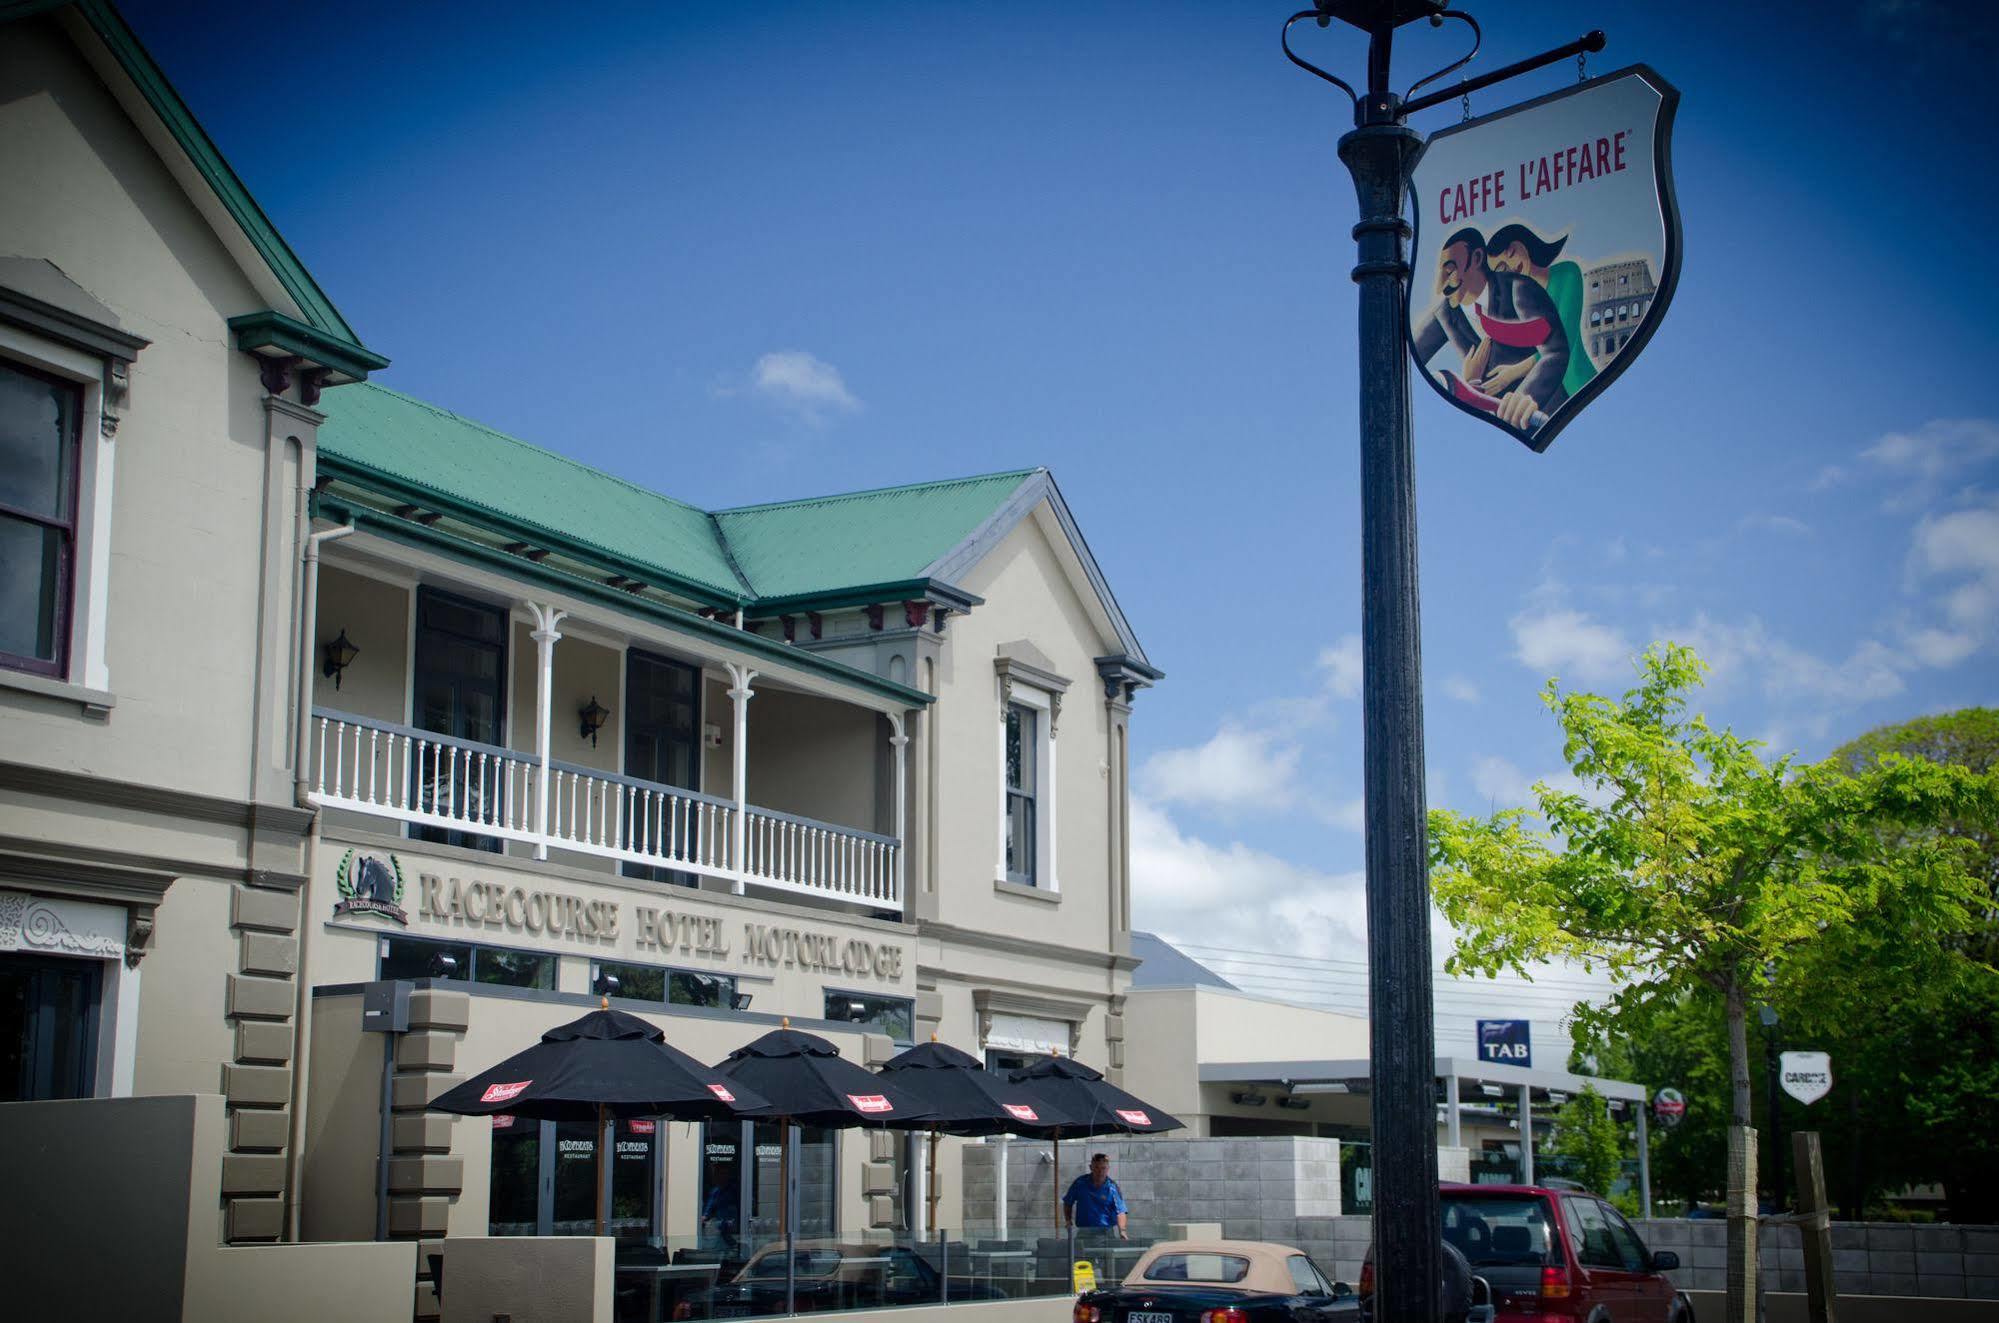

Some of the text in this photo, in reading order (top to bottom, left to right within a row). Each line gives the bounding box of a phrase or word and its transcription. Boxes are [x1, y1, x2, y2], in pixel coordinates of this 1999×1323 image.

[1439, 131, 1627, 224] CAFFE L'AFFARE
[419, 872, 904, 978] RACECOURSE HOTEL MOTORLODGE
[1483, 1043, 1528, 1058] TAB
